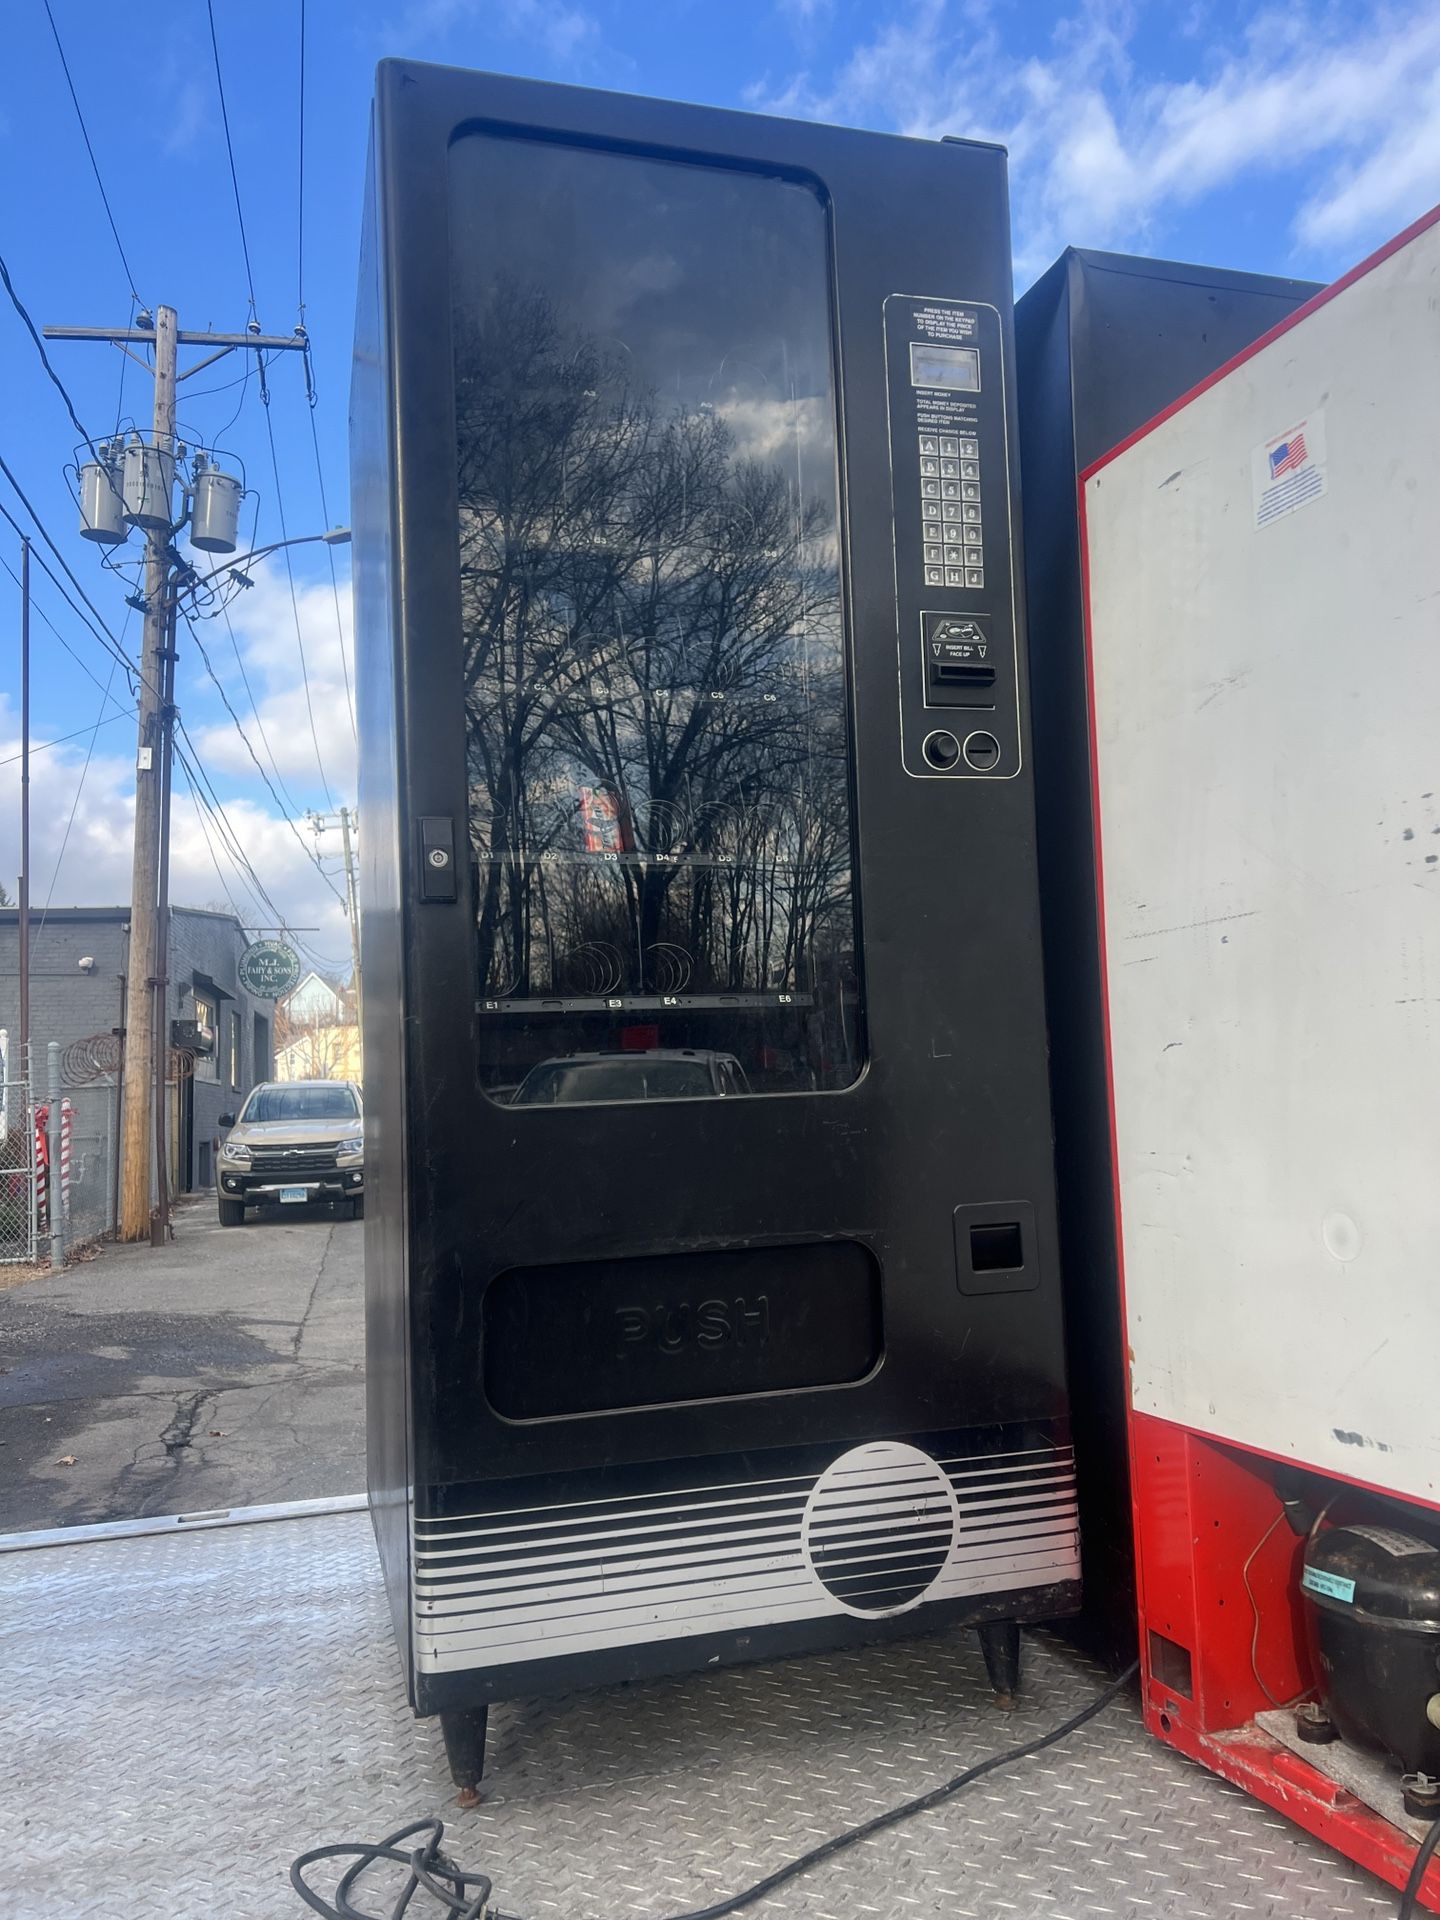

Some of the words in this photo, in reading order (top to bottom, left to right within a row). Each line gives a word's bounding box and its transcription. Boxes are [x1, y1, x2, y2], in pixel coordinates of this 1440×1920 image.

[935, 332, 962, 340] PURCHASE
[949, 401, 977, 409] DEPOSITED
[953, 415, 978, 423] MATCHING
[925, 441, 934, 450] A
[947, 443, 951, 452] 1
[966, 444, 973, 454] 2
[927, 462, 935, 472] B
[947, 464, 954, 473] 3
[966, 466, 973, 475] 4
[927, 484, 935, 494] C
[948, 486, 955, 495] 5
[967, 487, 974, 496] 6
[928, 505, 937, 515] D
[948, 507, 955, 516] 7
[969, 509, 975, 518] 8
[929, 527, 937, 537] E
[950, 528, 957, 538] 9
[969, 531, 976, 539] 0
[930, 571, 939, 580] G
[950, 572, 959, 582] H
[971, 573, 978, 583] J
[533, 683, 547, 691] C2
[655, 689, 668, 697] C4
[481, 851, 494, 859] D1
[543, 852, 557, 860] D2
[247, 966, 265, 974] FAHY
[663, 997, 677, 1005] E4
[778, 995, 792, 1003] E6
[615, 1296, 770, 1358] PUSH
